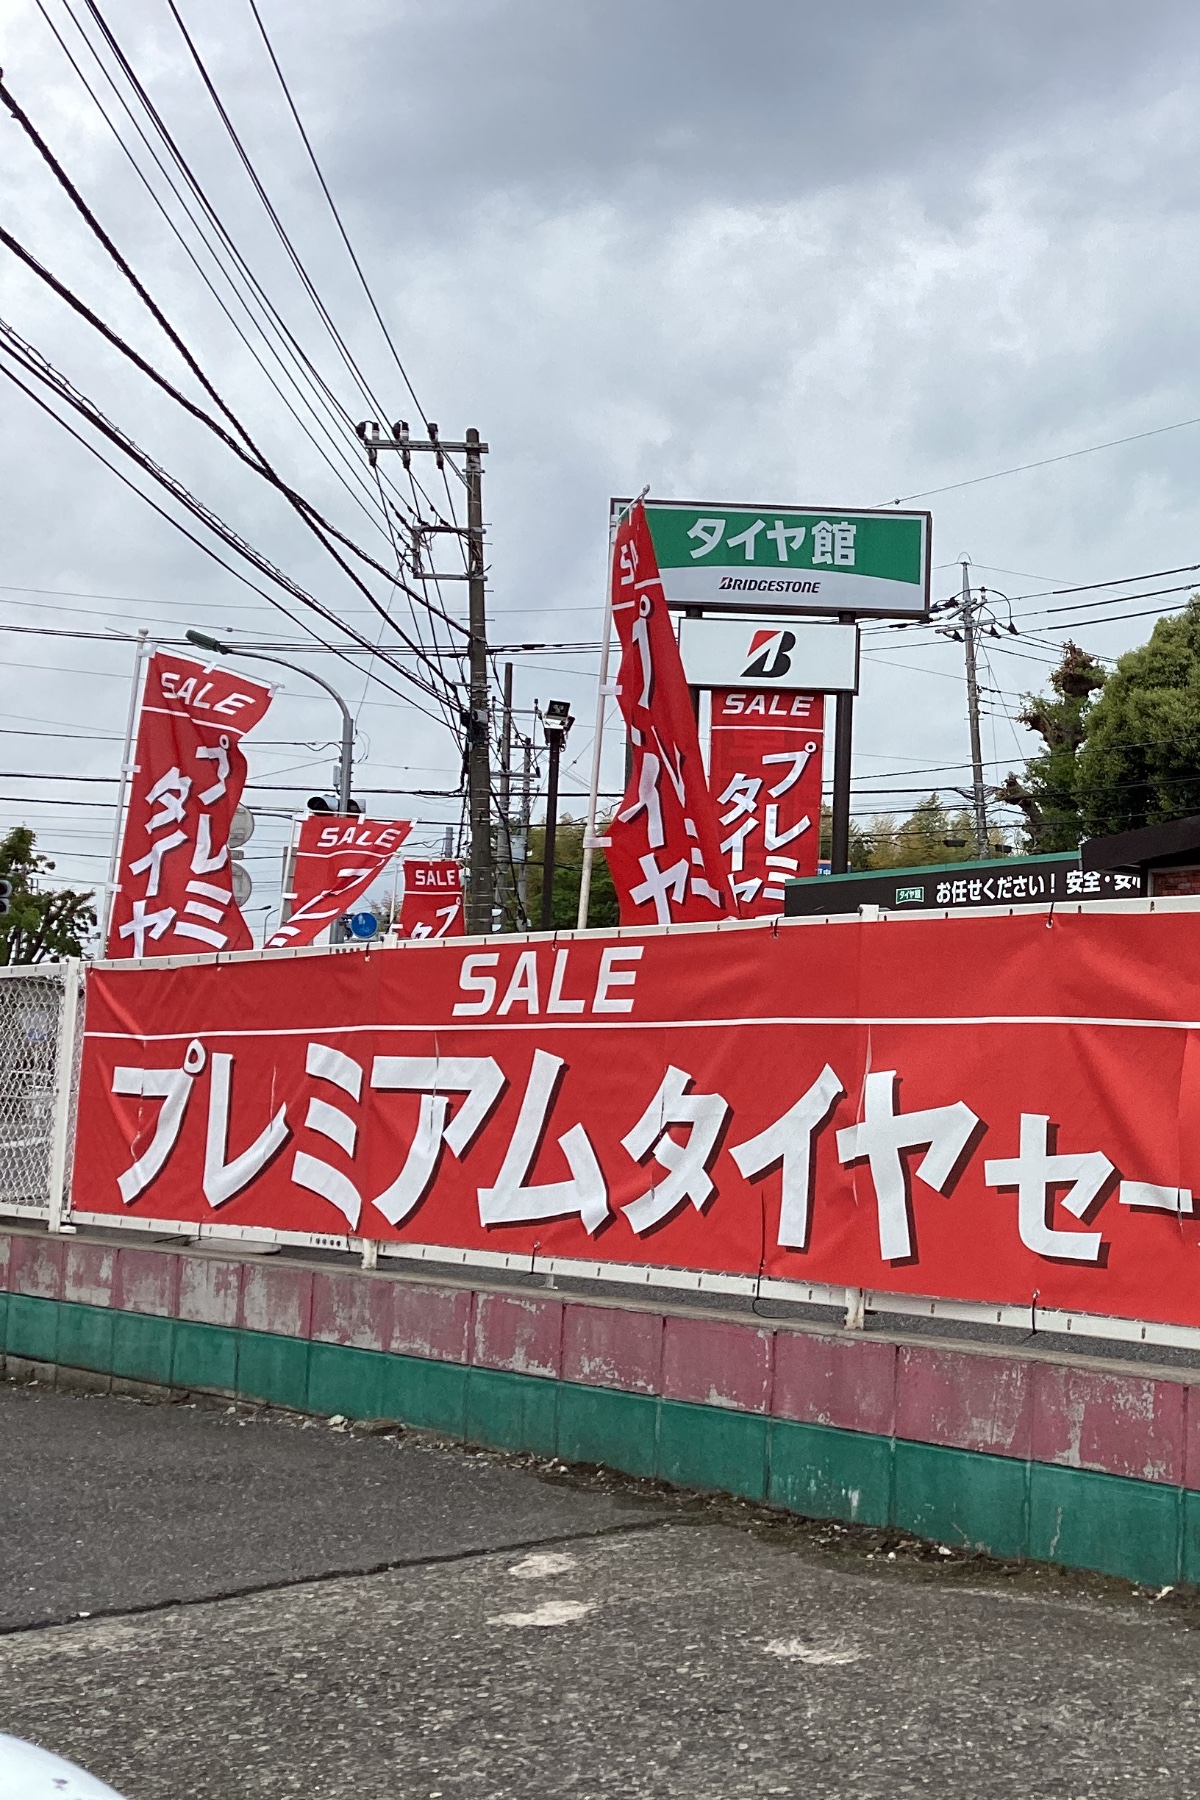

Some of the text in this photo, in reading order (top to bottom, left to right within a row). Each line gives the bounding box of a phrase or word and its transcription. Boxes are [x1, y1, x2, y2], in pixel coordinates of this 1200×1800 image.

[686, 517, 857, 566] タイヤ館
[718, 576, 821, 594] BRIDGESTONE
[160, 671, 256, 716] SALE
[721, 693, 816, 717] SALE
[172, 734, 233, 951] プレミ
[317, 826, 402, 849] SALE
[119, 766, 193, 958] タイヤ
[415, 869, 456, 886] SALE
[451, 945, 644, 1017] SALE
